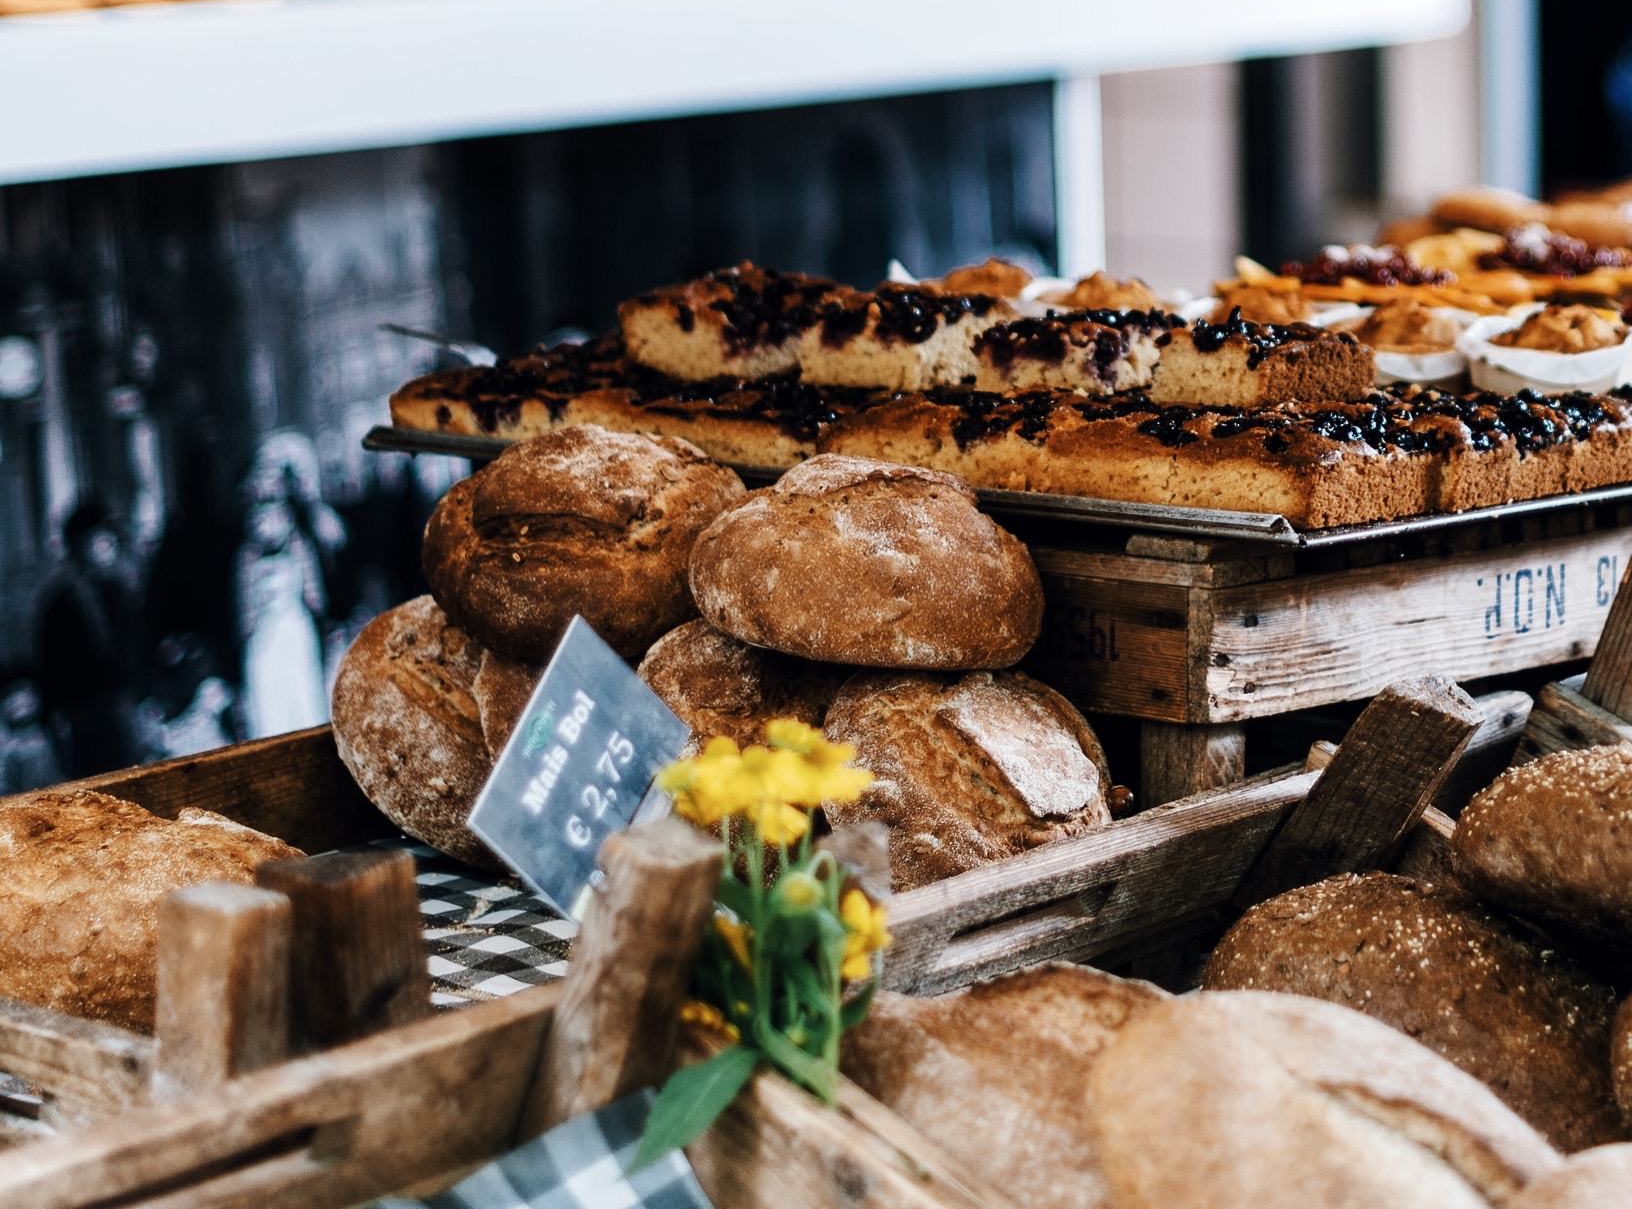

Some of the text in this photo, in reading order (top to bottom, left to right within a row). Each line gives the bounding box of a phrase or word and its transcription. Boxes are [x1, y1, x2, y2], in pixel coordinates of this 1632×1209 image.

[521, 744, 570, 816] Mais
[557, 688, 597, 745] Bol
[580, 730, 635, 820] 2,75
